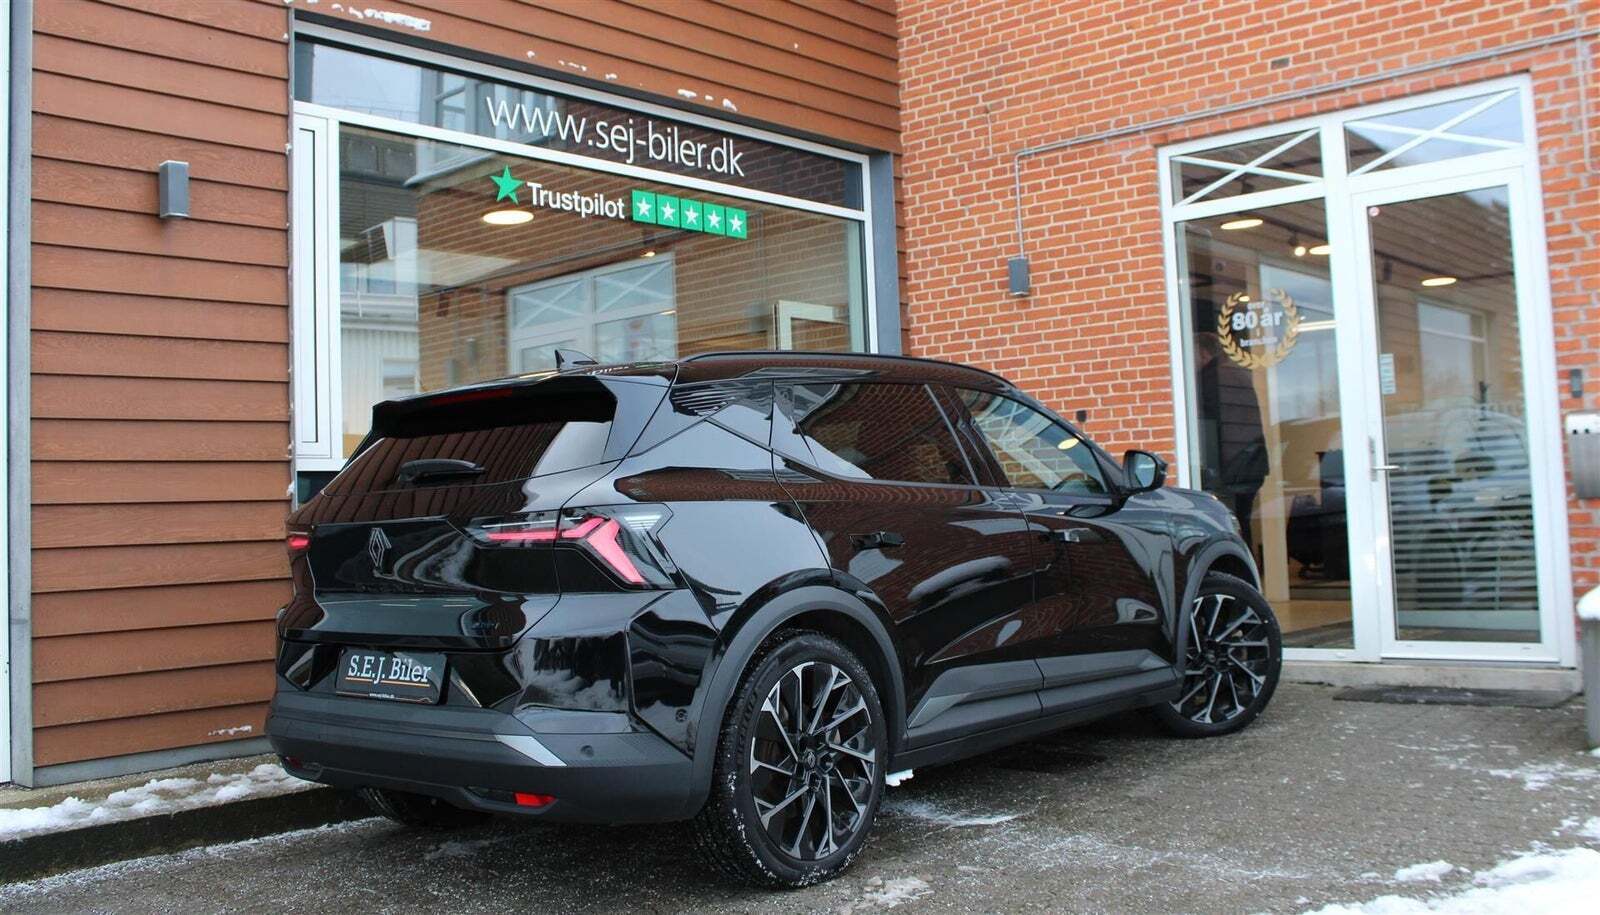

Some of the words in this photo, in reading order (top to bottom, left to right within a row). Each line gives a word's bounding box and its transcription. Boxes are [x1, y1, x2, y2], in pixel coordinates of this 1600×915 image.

[486, 96, 745, 177] www.sej-biler.dk
[527, 181, 625, 219] Trustpilot
[1232, 312, 1258, 331] 80
[1260, 307, 1283, 326] år
[347, 655, 386, 684] S.E.J.
[388, 657, 432, 682] Biler
